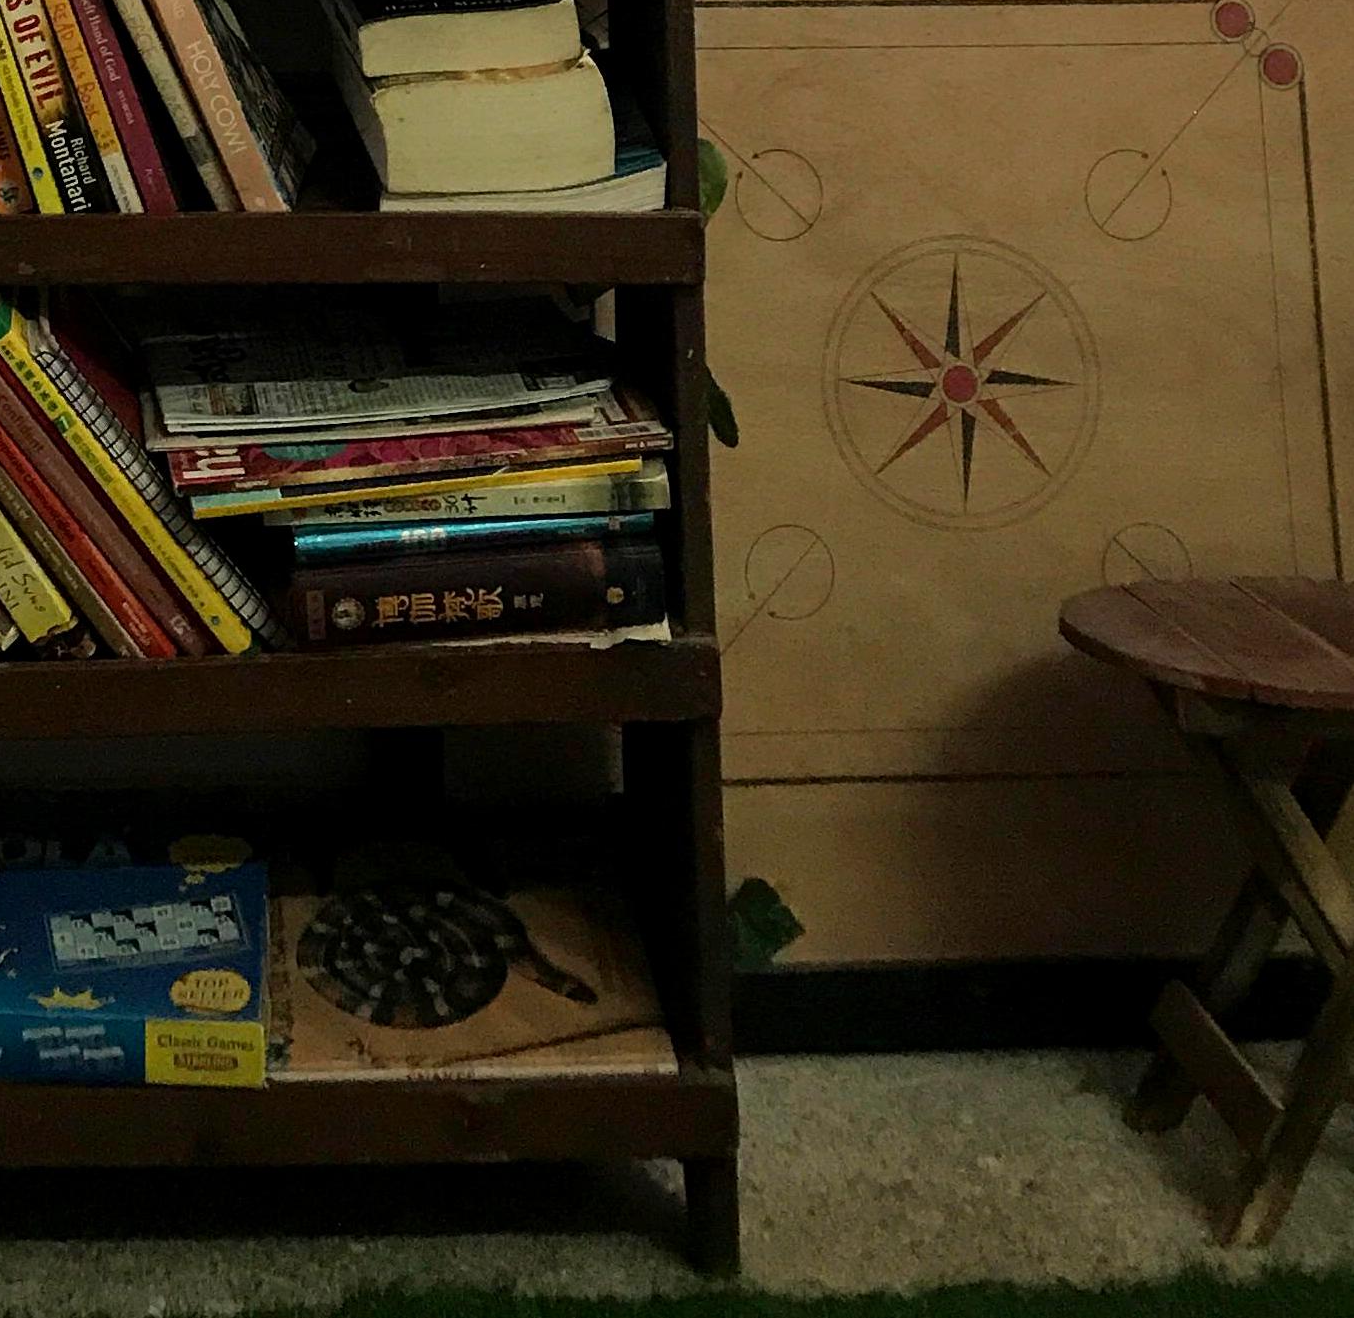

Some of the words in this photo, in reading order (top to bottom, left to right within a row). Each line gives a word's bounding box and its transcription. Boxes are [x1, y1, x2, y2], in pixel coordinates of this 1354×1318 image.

[13, 15, 46, 46] OF
[86, 14, 108, 44] Hand
[102, 57, 120, 82] God
[24, 51, 63, 110] EVIL
[181, 38, 222, 94] HOLY
[45, 119, 93, 214] Montanari
[69, 136, 96, 186] Richard
[11, 572, 48, 614] Suns
